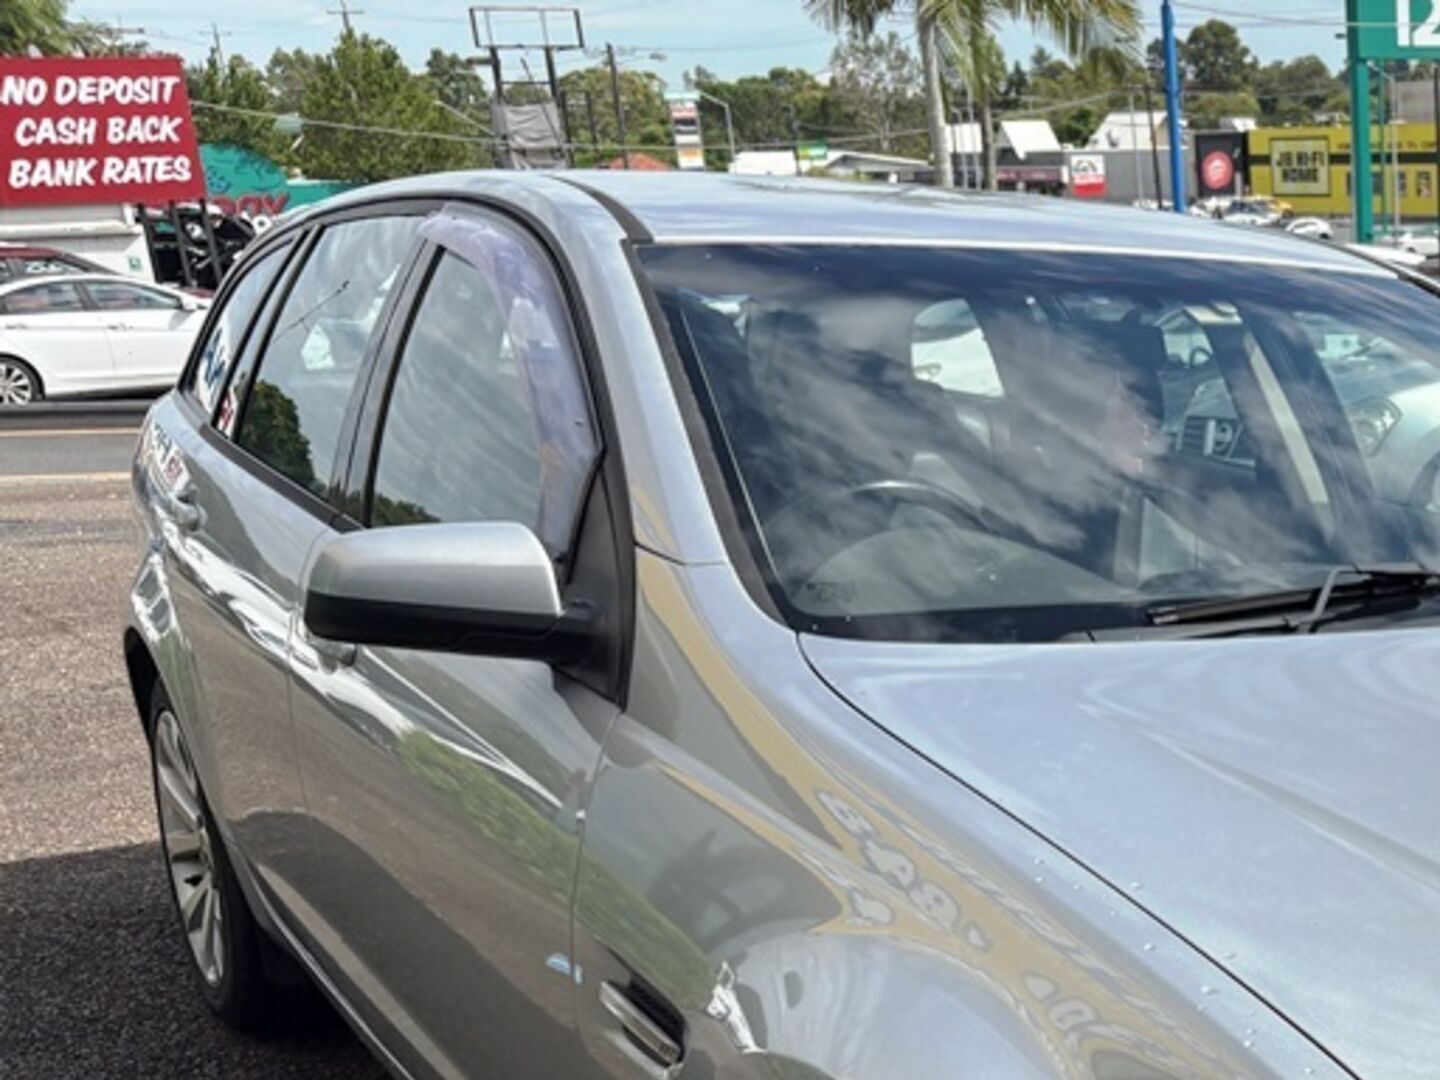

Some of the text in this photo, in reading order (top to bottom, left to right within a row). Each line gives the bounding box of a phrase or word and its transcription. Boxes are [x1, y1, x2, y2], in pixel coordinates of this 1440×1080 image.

[1, 75, 181, 106] NO DEPOSIT
[14, 115, 183, 147] CASH BACK
[8, 155, 192, 189] BANK RATES
[1276, 151, 1292, 167] JB
[1281, 168, 1319, 184] HOME
